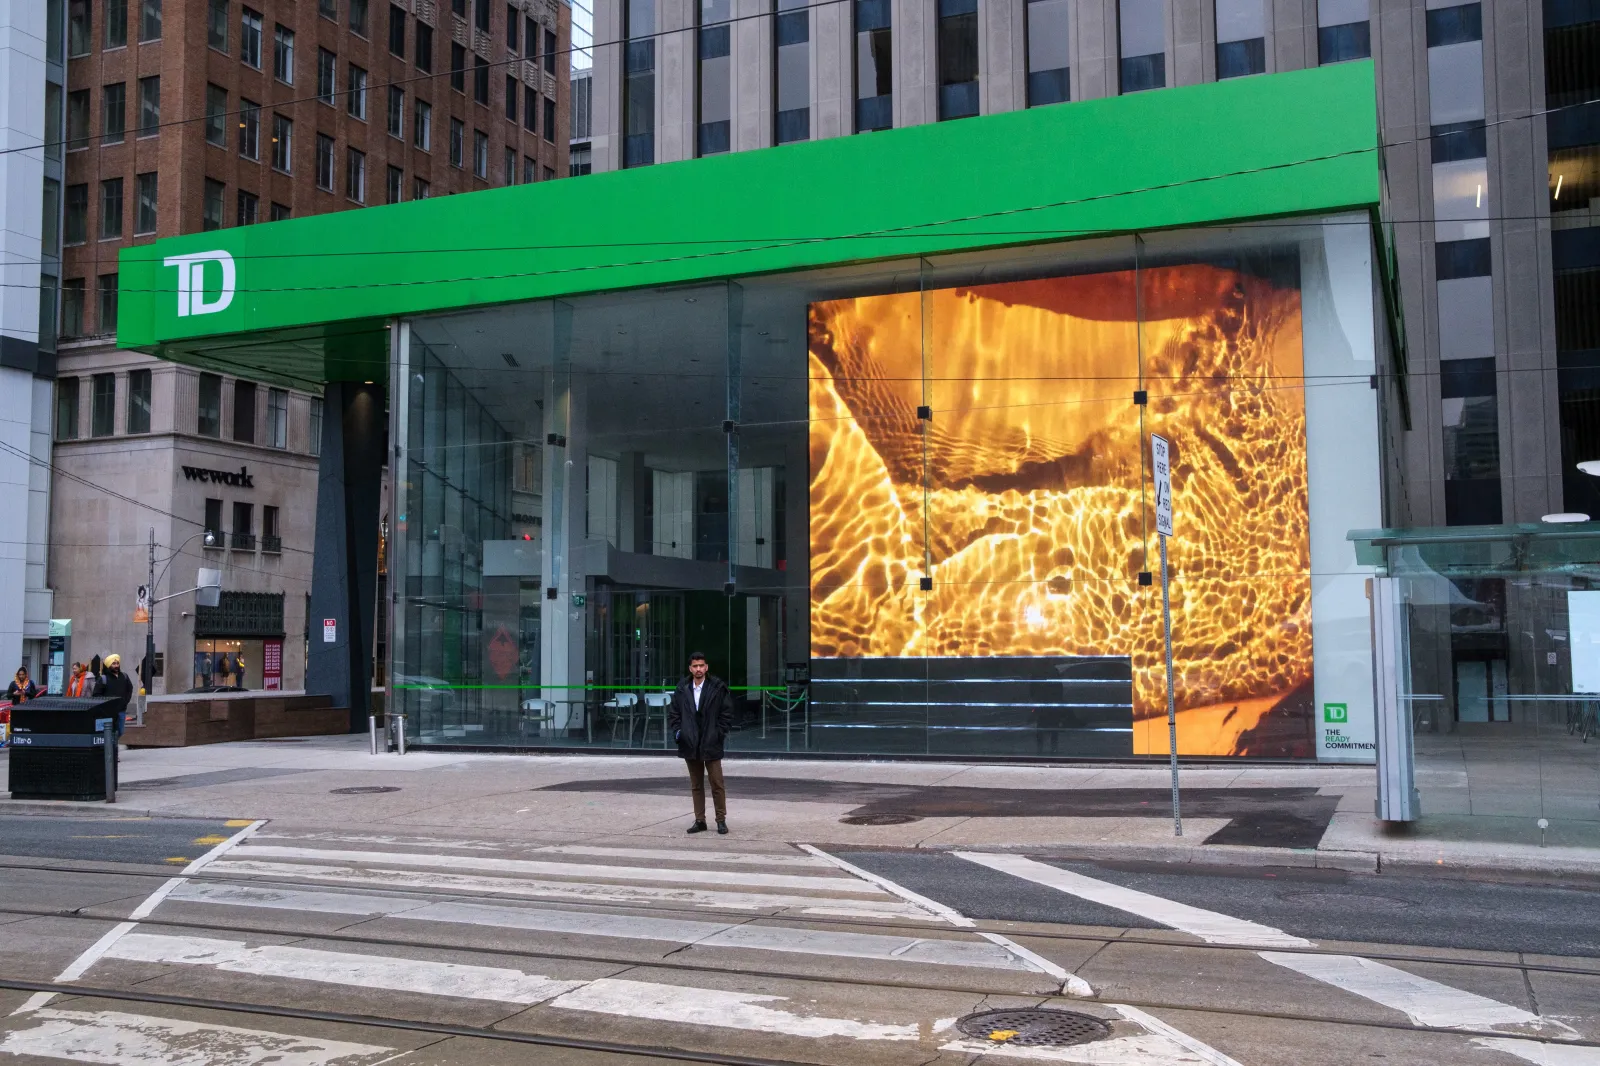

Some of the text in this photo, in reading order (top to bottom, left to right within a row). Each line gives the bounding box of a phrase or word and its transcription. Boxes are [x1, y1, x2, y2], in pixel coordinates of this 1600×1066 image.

[164, 250, 236, 317] TD
[1156, 442, 1166, 457] STOP
[1157, 461, 1166, 476] HERE
[182, 465, 255, 488] wework
[1164, 481, 1170, 493] ON
[1158, 514, 1171, 530] SIGNAL
[1326, 706, 1345, 719] TD
